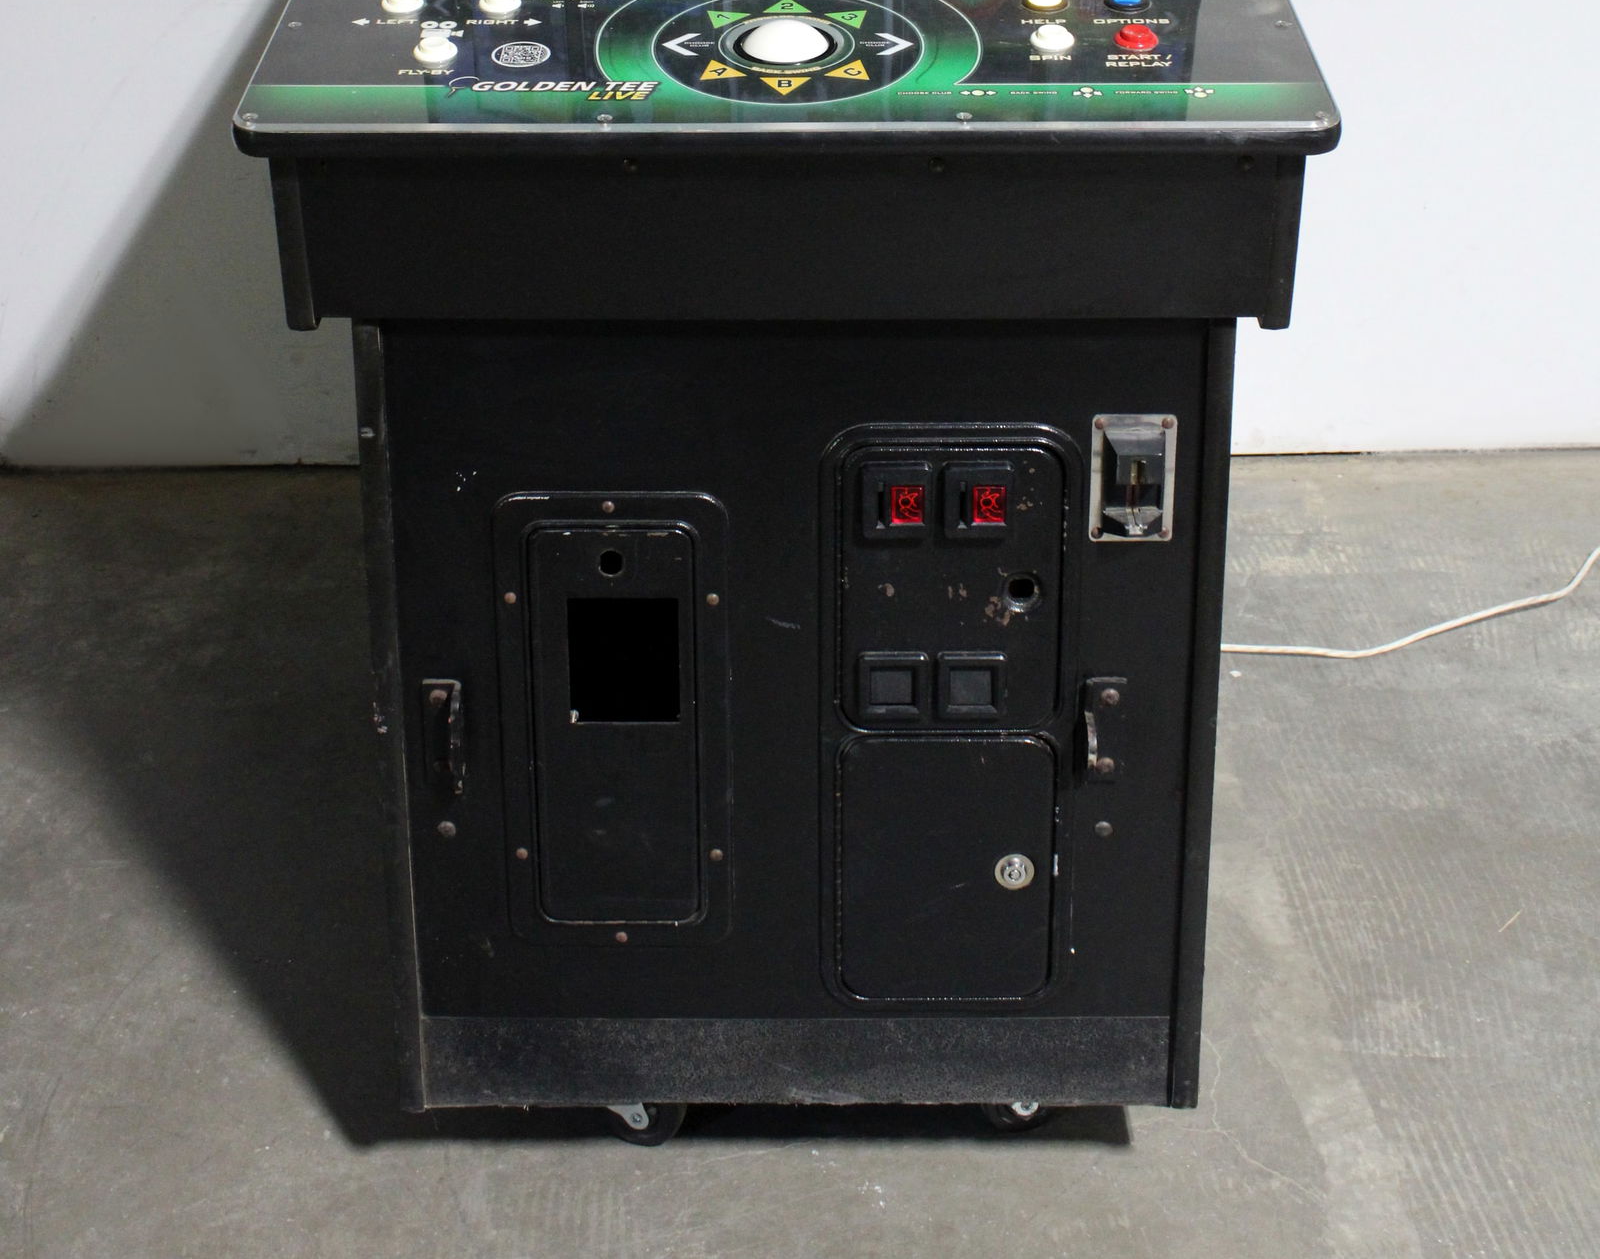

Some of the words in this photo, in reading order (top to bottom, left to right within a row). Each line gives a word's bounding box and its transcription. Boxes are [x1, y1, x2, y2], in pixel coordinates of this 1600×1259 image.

[780, 2, 794, 10] 2
[842, 13, 858, 22] 3
[708, 67, 727, 76] A
[843, 67, 862, 76] C
[471, 80, 596, 92] GOLDEN
[603, 80, 659, 92] TEE
[777, 80, 793, 88] B
[588, 90, 650, 100] LIVE
